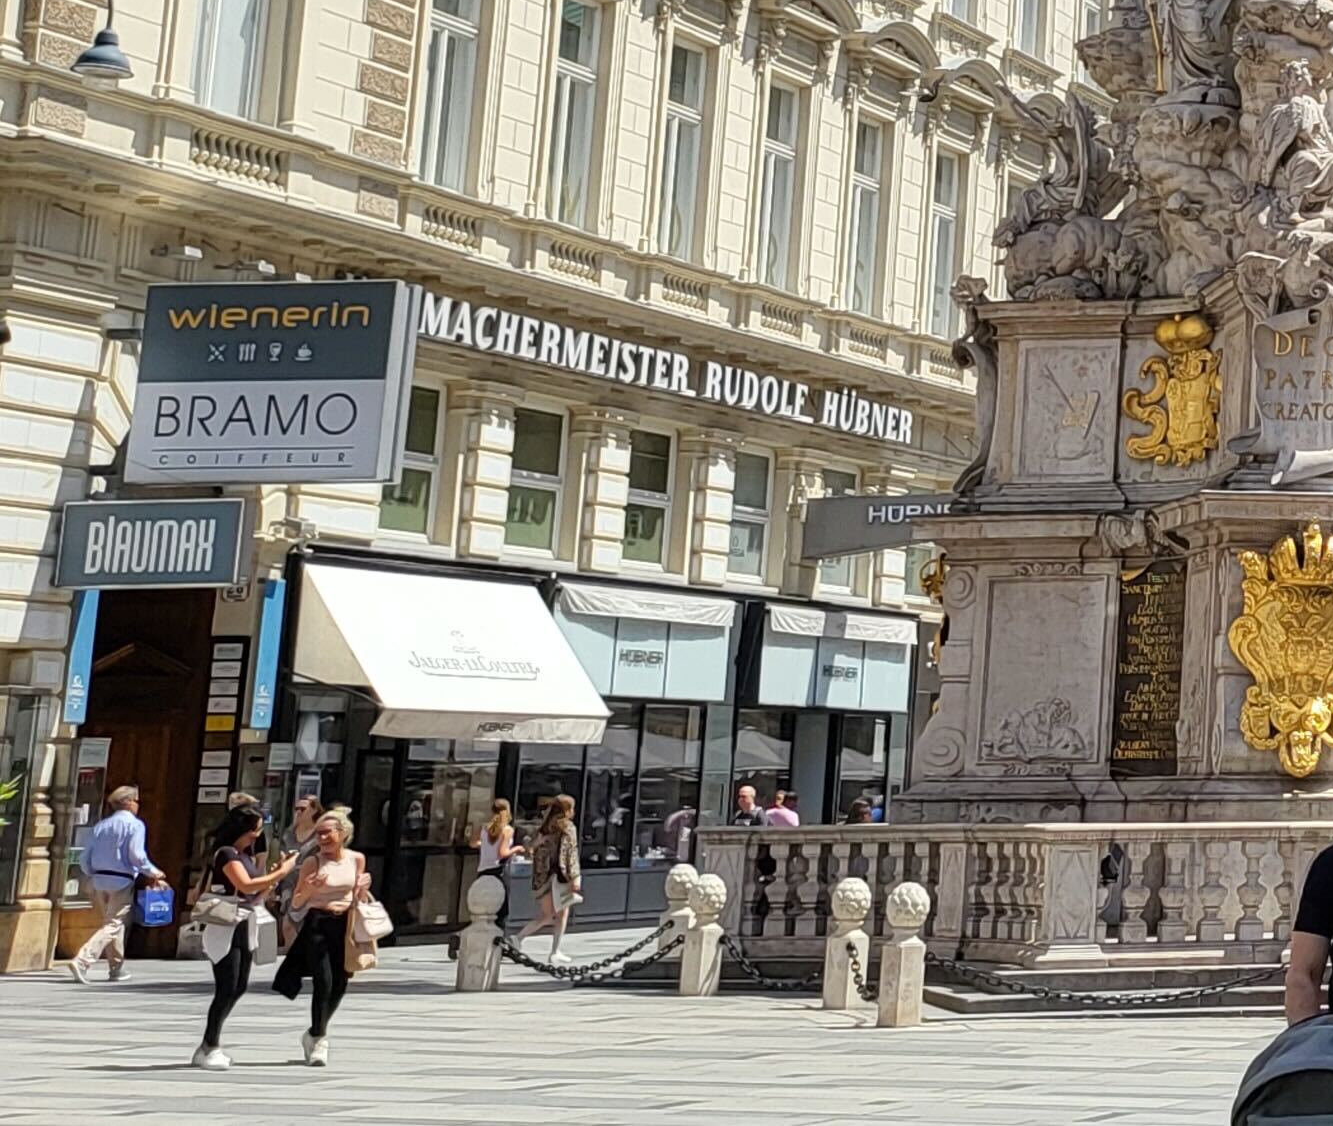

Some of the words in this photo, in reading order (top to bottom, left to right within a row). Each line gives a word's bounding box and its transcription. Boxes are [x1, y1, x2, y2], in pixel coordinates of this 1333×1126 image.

[168, 301, 371, 331] wienerin
[153, 392, 359, 439] BRAMO
[821, 385, 914, 445] HÜBNER
[158, 451, 348, 466] COIFFEUR
